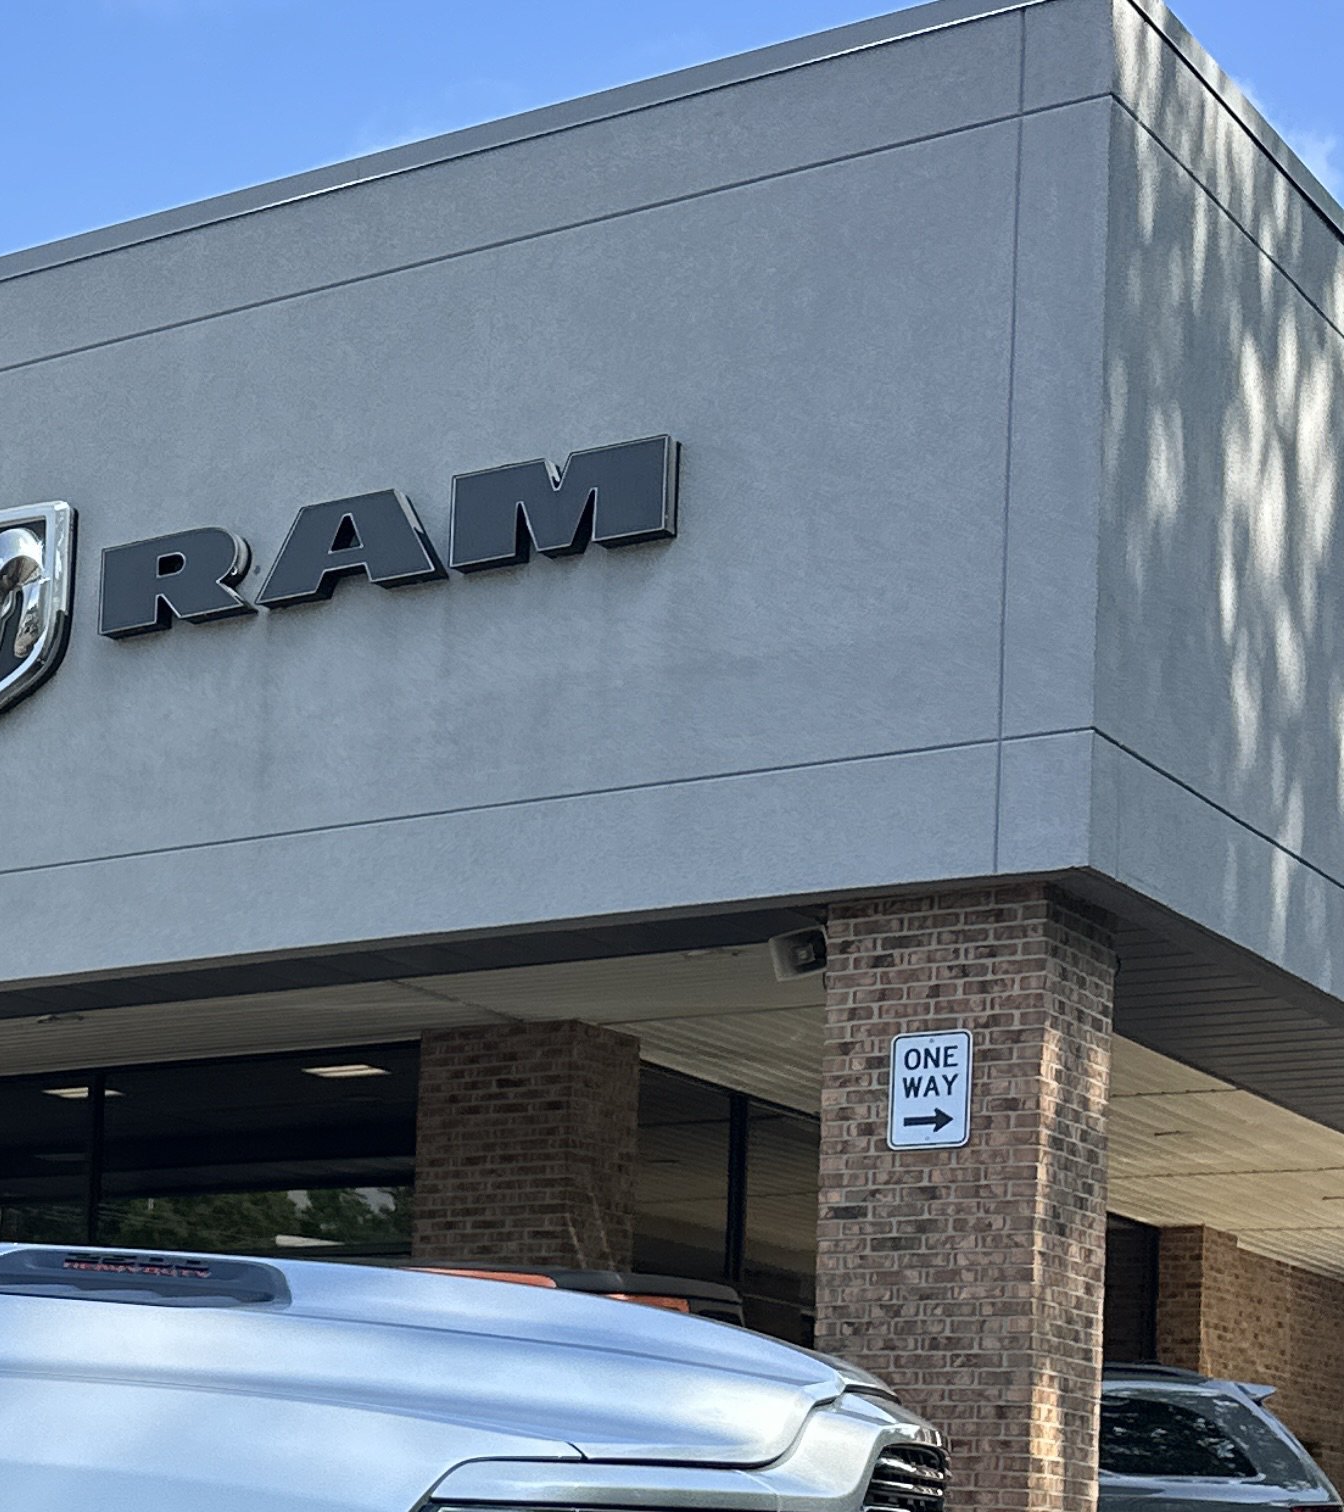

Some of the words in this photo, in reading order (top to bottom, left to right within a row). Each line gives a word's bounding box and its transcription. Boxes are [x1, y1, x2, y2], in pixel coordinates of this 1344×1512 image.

[98, 434, 679, 639] RAM
[903, 1045, 959, 1070] ONE
[902, 1073, 959, 1099] WAY
